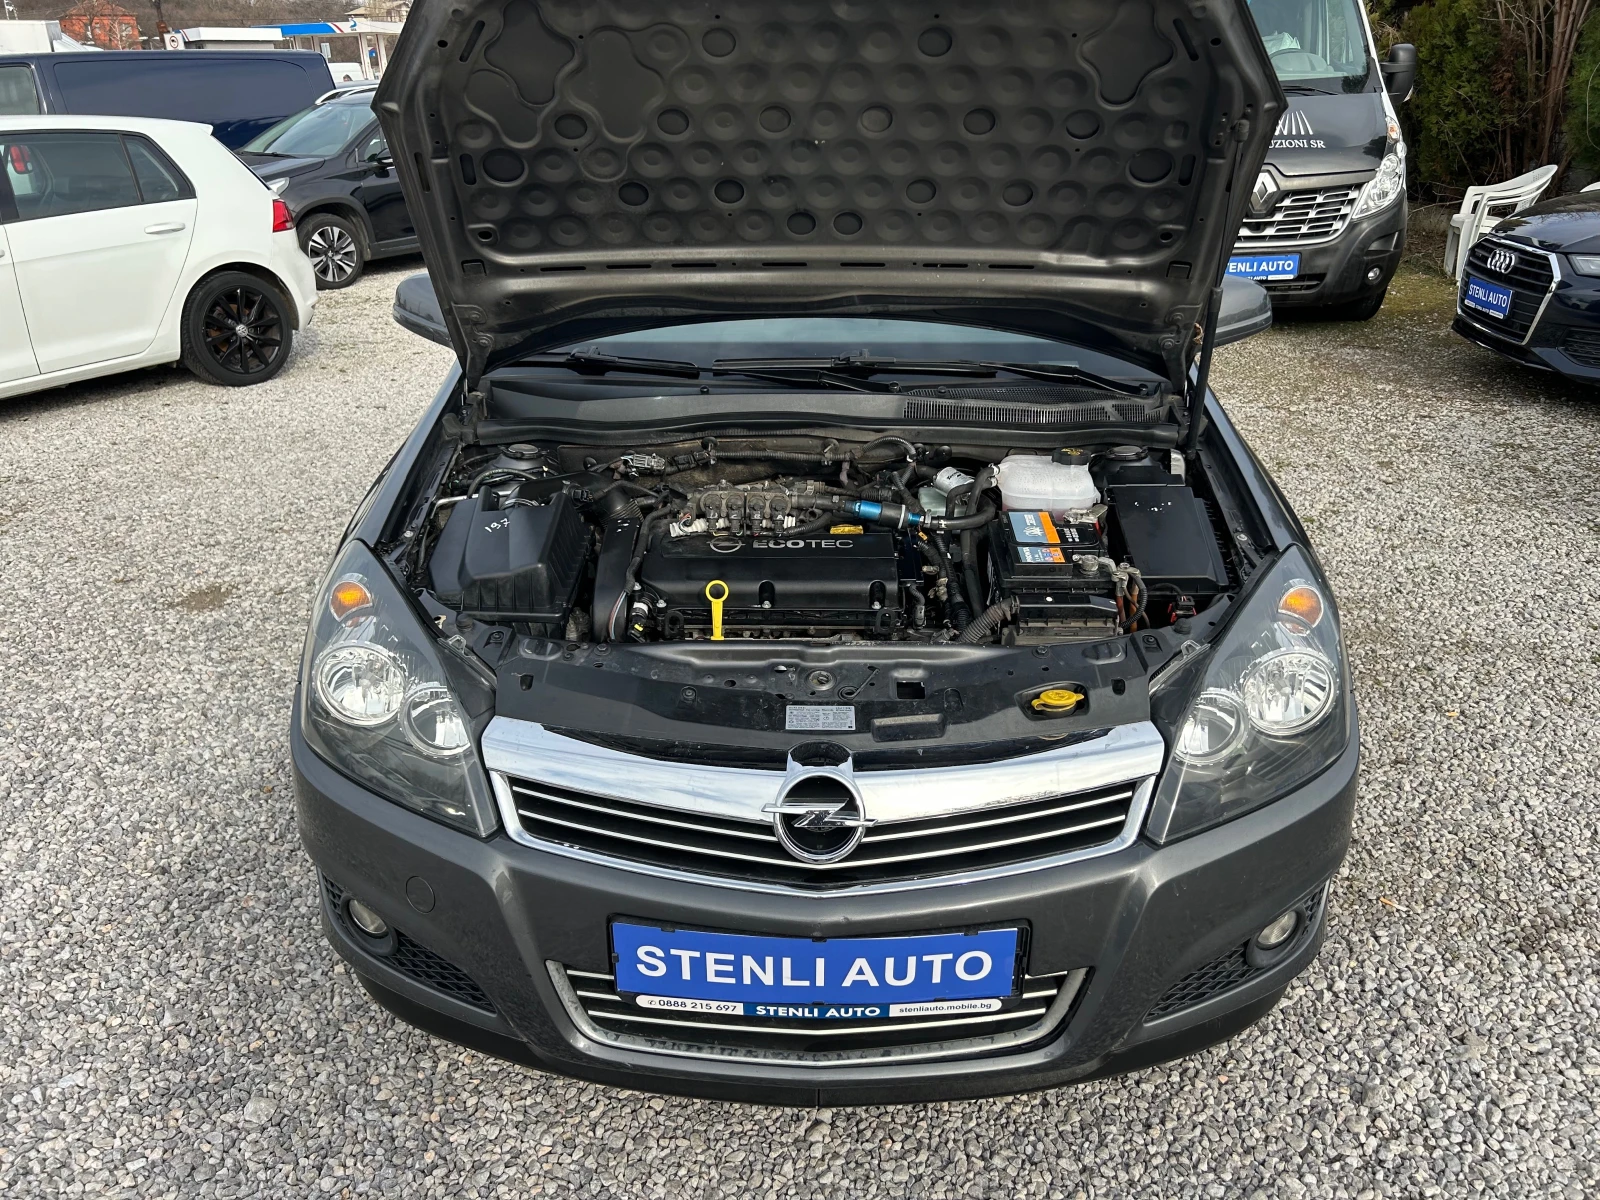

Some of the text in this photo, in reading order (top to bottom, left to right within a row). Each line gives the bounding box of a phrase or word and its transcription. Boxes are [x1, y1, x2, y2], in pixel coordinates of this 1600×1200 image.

[1310, 140, 1326, 148] SR
[1228, 260, 1294, 272] ENLI AUTO
[1468, 284, 1488, 301] STENLI
[1488, 292, 1508, 307] AUTO
[752, 539, 854, 549] ECOTEC
[636, 945, 992, 987] STENLI AUTO
[658, 999, 737, 1012] 0888 215 697
[755, 1005, 881, 1017] STENLI AUTO
[899, 1002, 992, 1014] stenliauto.mobile.bg
